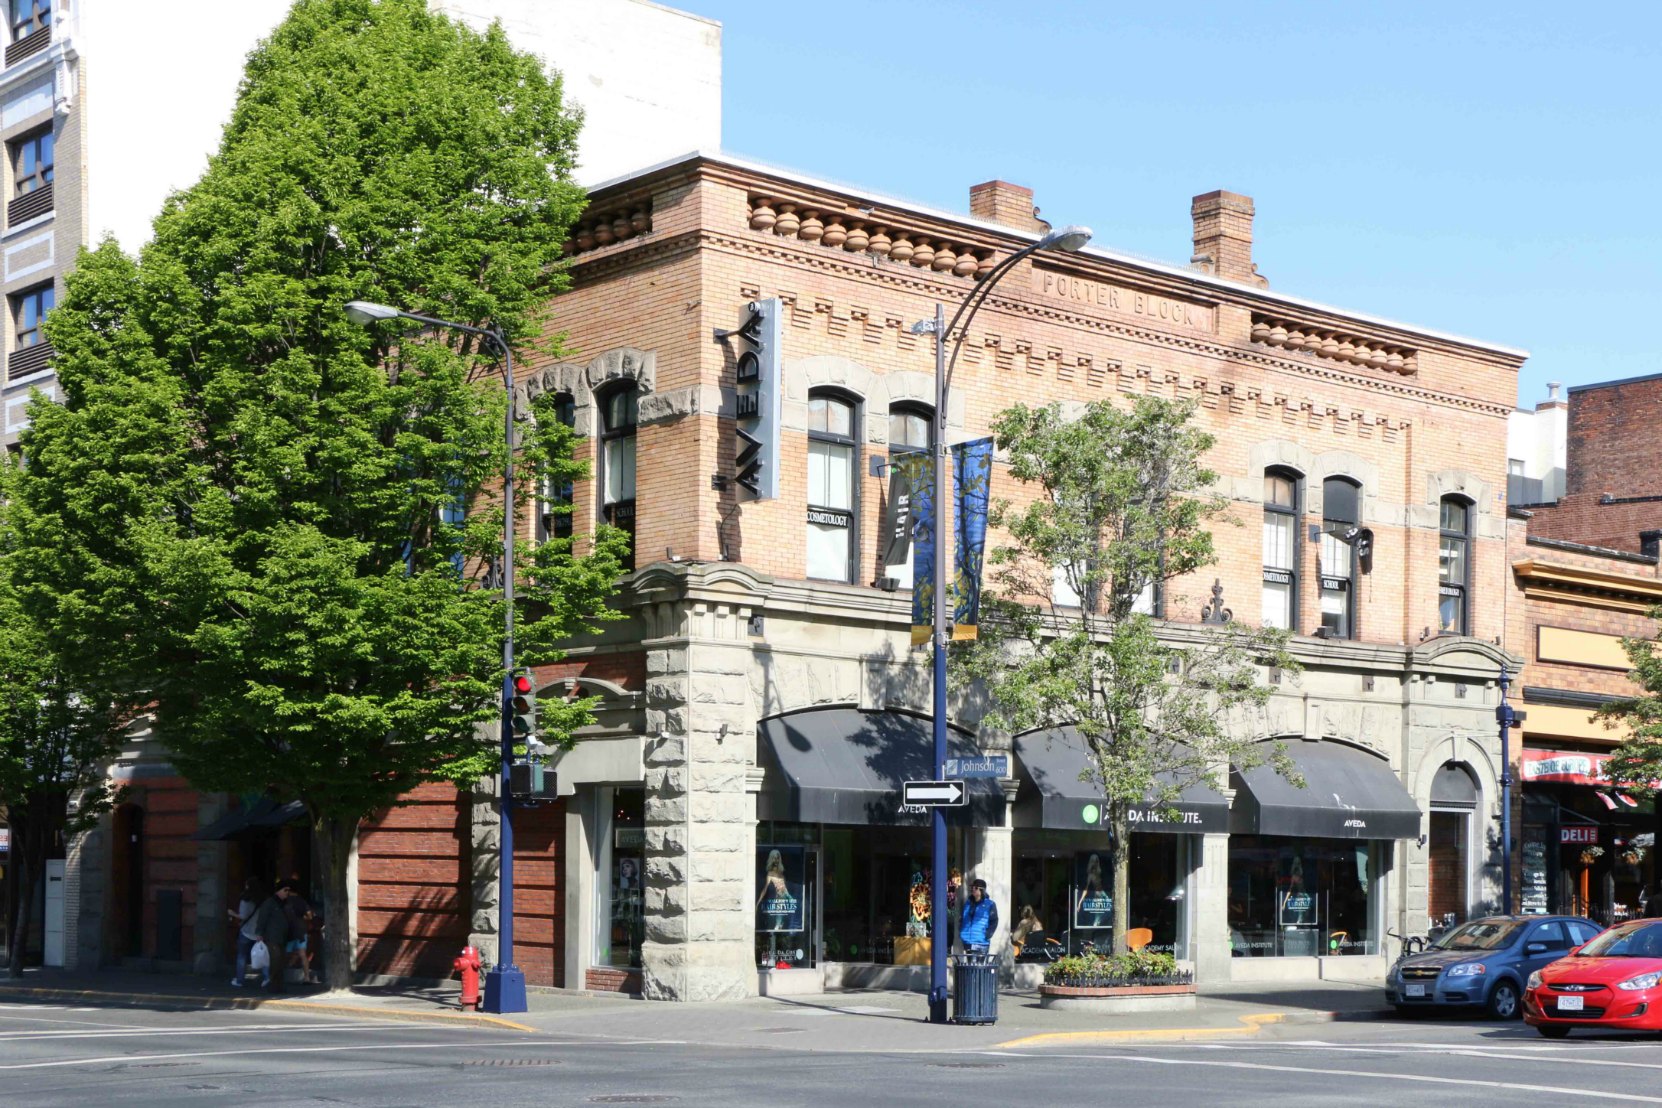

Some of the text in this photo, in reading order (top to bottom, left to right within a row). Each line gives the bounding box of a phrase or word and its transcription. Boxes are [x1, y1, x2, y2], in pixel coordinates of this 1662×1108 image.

[1043, 271, 1193, 325] PORTER BLOCK
[735, 308, 765, 498] AVEDA
[807, 511, 847, 526] COSMETOLOGY
[961, 760, 995, 774] Johnson
[995, 766, 1007, 774] 600
[898, 805, 928, 814] AVEDA
[1343, 819, 1367, 828] AVEDA
[1561, 829, 1588, 842] DELI
